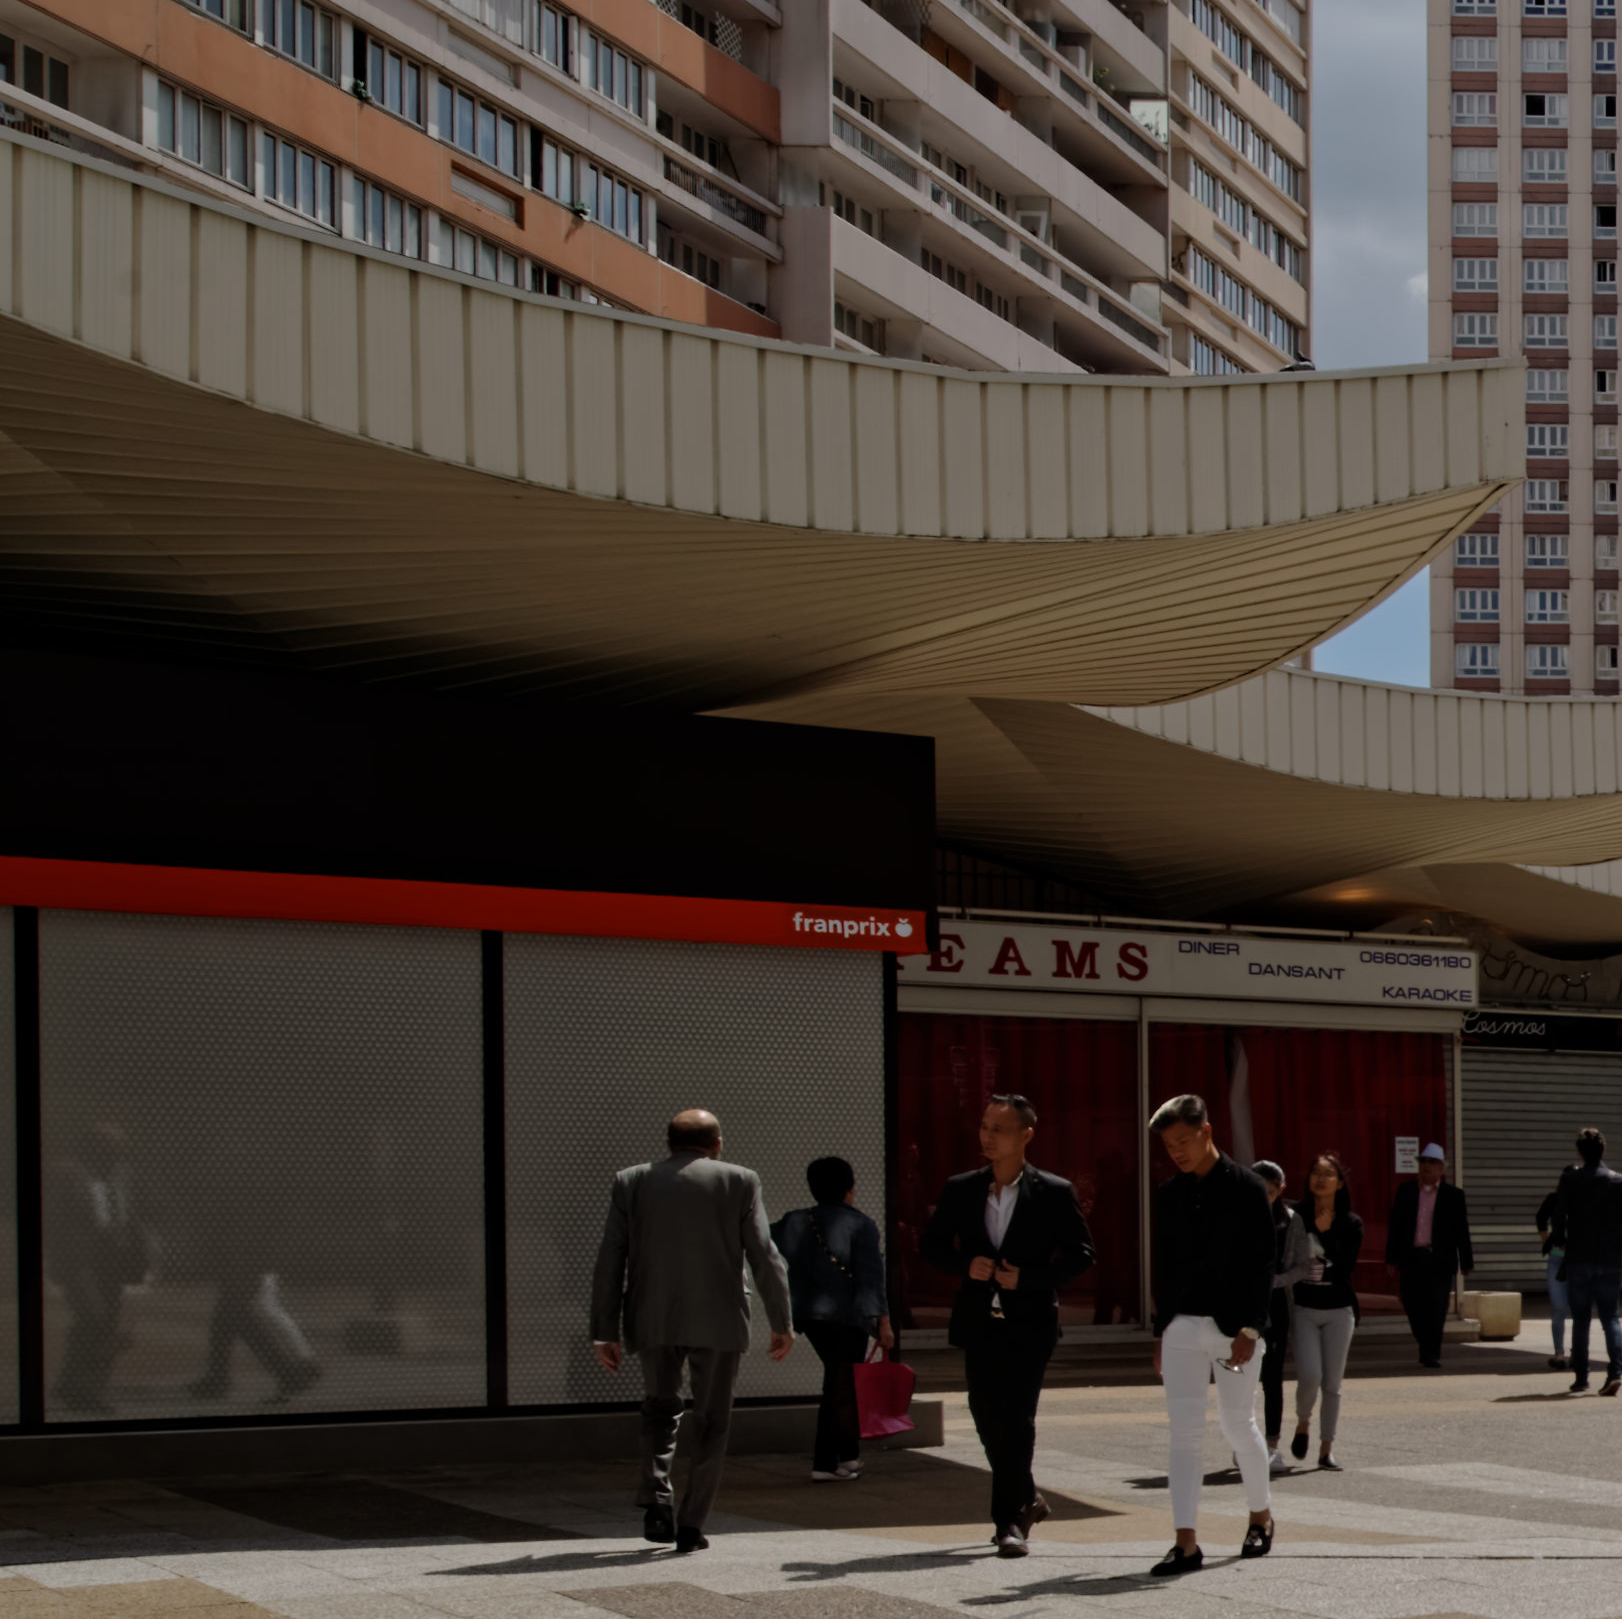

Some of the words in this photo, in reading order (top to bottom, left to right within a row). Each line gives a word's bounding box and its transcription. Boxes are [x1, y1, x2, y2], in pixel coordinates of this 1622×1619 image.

[792, 912, 891, 938] franprix
[1178, 940, 1240, 956] DINER
[895, 934, 1149, 981] EAMS
[1360, 951, 1472, 969] 0660361180
[1248, 962, 1345, 980] DANSANT
[1382, 986, 1473, 1003] KARAOKE
[1462, 1010, 1546, 1035] Cosmos
